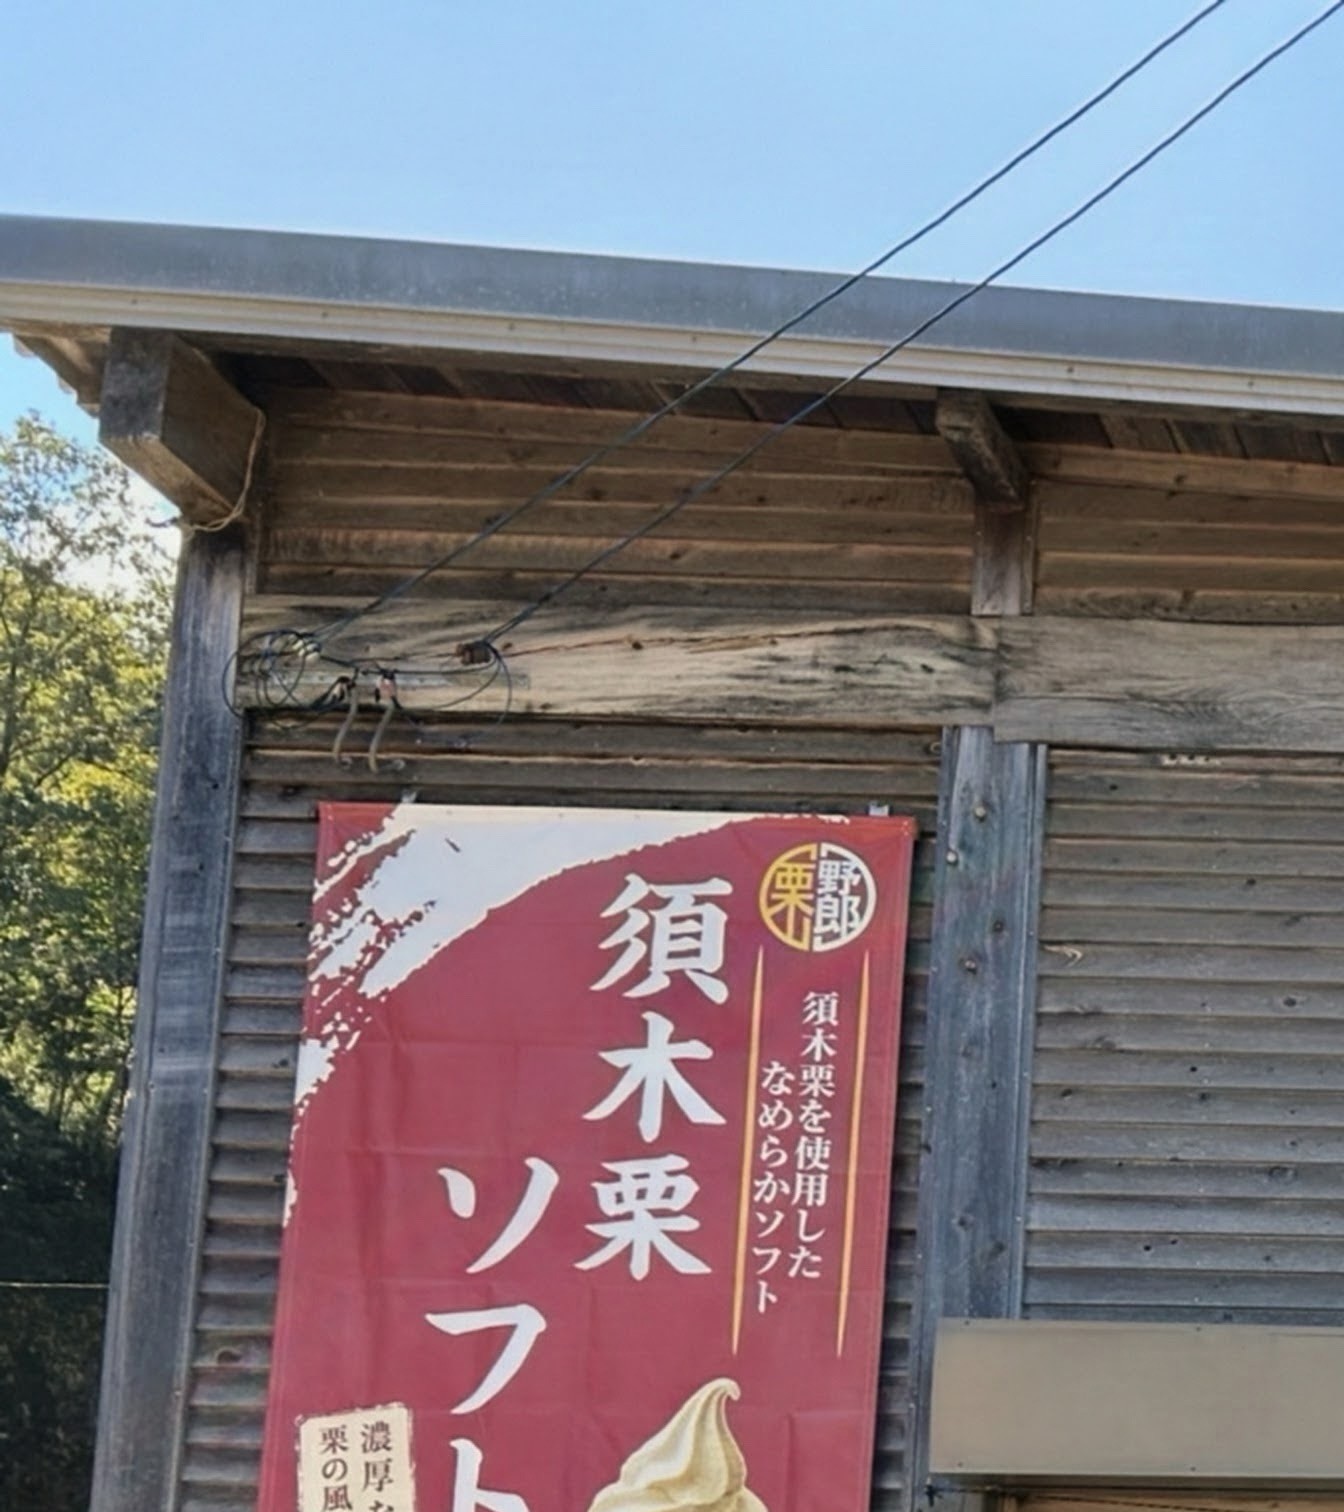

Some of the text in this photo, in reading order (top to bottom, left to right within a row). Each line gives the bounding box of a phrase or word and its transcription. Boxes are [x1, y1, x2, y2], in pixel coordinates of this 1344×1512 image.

[574, 873, 734, 1280] 須木栗
[752, 1060, 795, 1314] なめらかソフト
[788, 991, 839, 1279] 須木栗を使用した
